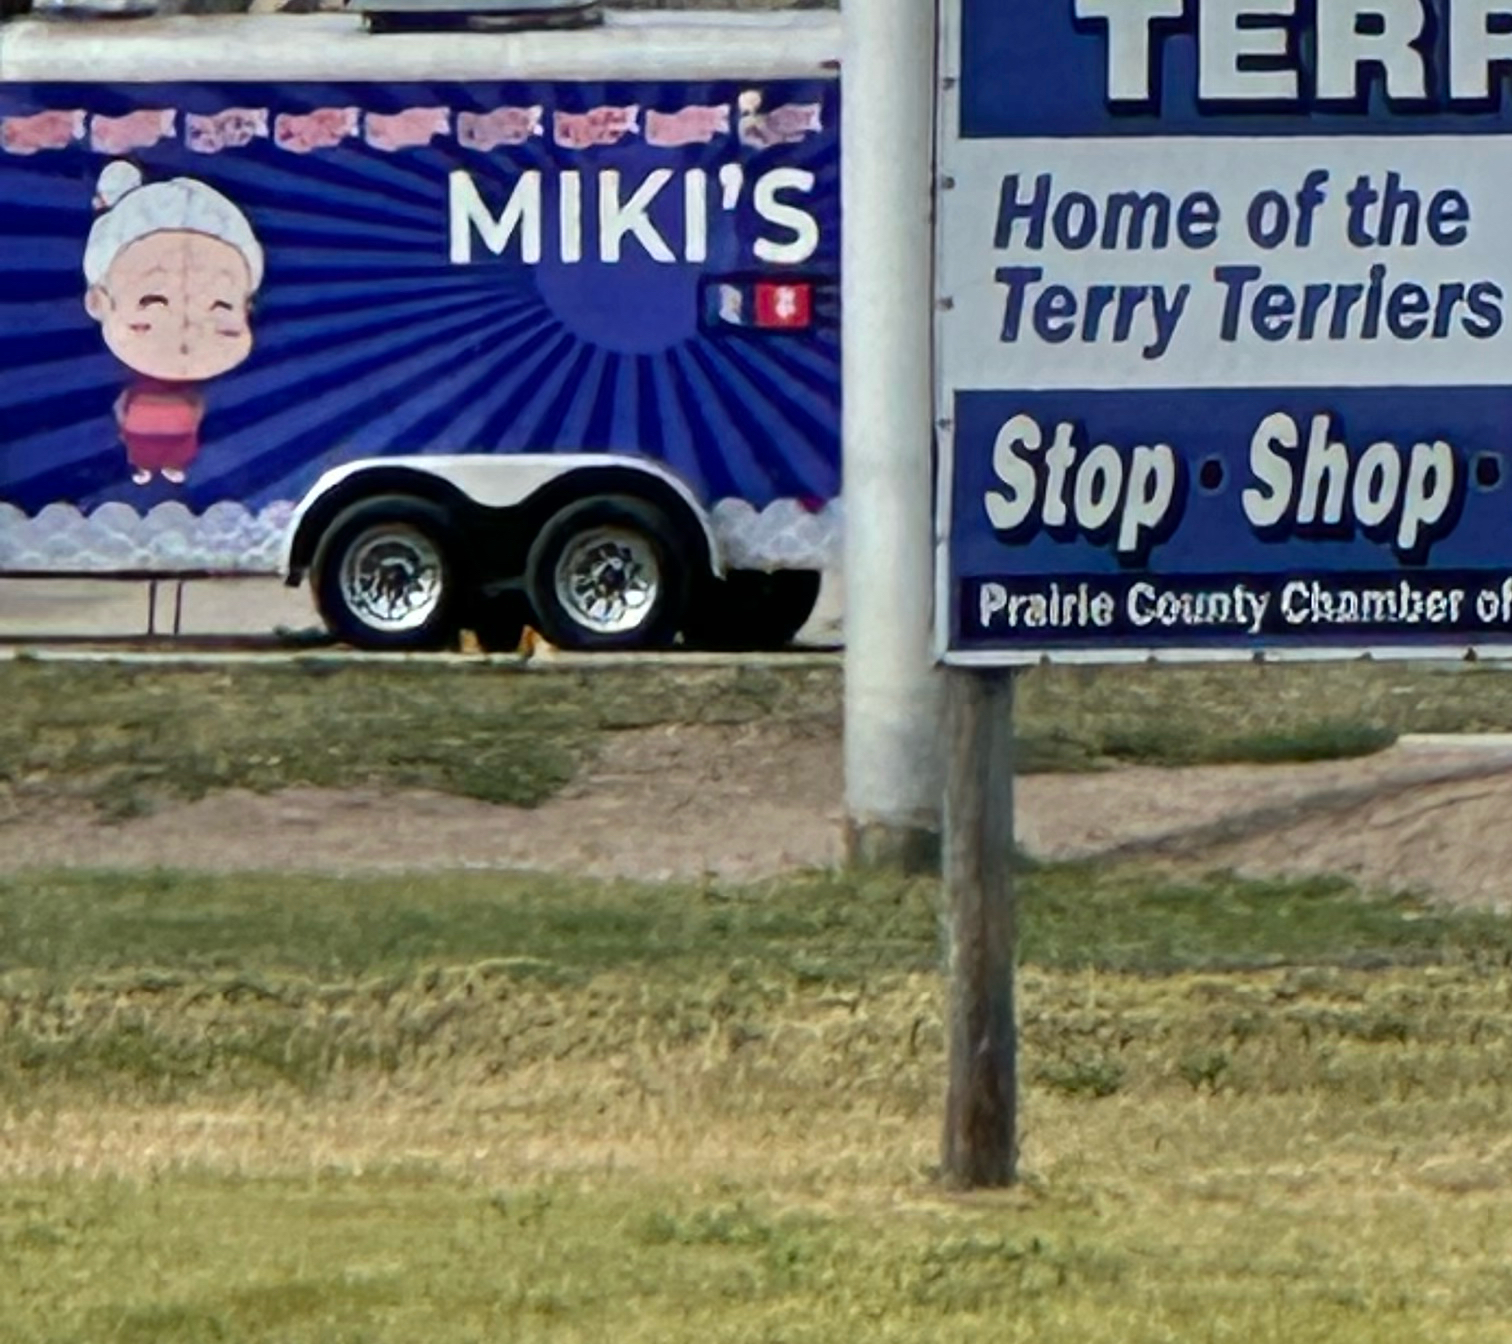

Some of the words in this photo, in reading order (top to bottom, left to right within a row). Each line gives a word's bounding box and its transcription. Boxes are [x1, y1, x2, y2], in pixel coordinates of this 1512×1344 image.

[447, 162, 821, 265] MIKI'S
[993, 171, 1220, 250] Home
[1246, 169, 1330, 248] of
[1345, 171, 1471, 247] the
[994, 265, 1191, 359] Terry
[1213, 263, 1504, 341] Terriers
[984, 413, 1176, 552] Stop
[1241, 411, 1456, 550] Shop
[978, 581, 1115, 628] Prairie
[1126, 581, 1272, 634] County
[1280, 579, 1465, 624] Chamber
